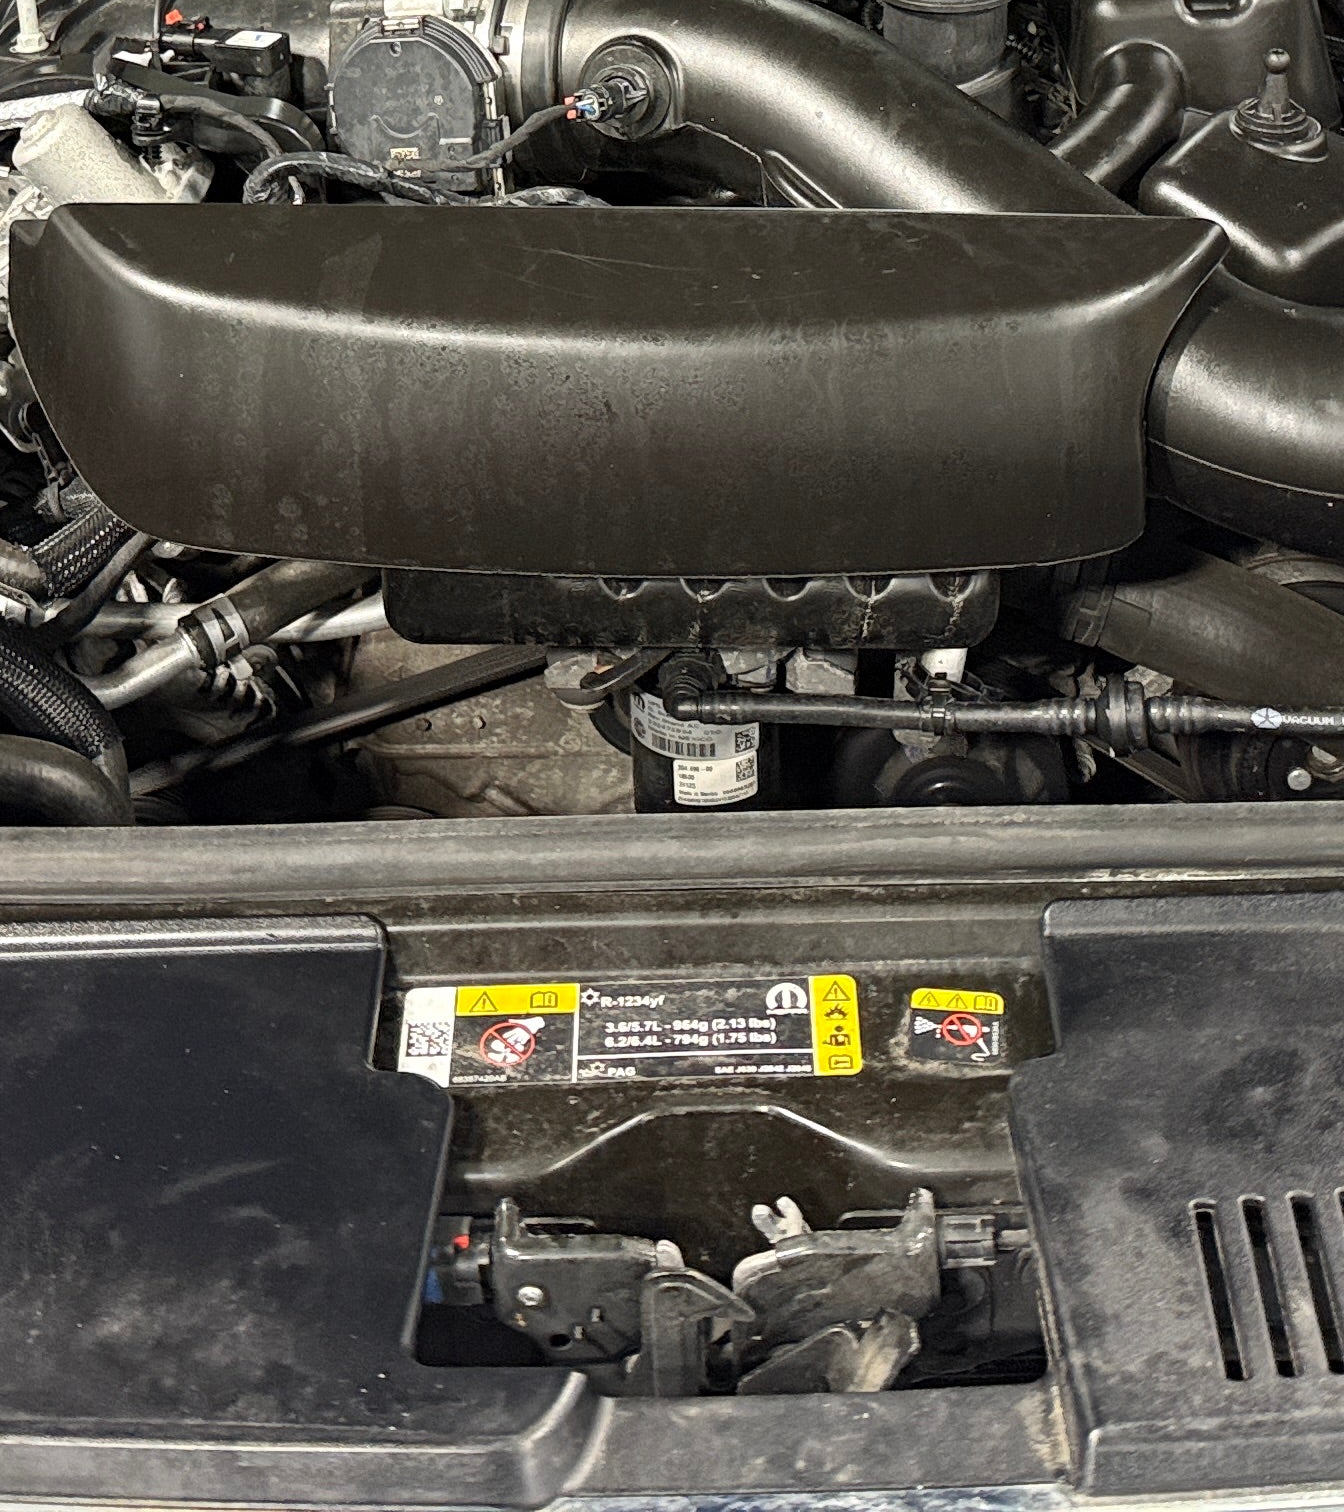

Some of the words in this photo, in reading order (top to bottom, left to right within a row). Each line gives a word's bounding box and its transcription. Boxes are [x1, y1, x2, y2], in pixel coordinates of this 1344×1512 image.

[1282, 715, 1334, 726] VACUUM
[600, 995, 665, 1008] R-1234yf
[605, 1020, 662, 1033] 3.6/5.7L
[712, 1018, 746, 1031] (2.13
[748, 1017, 776, 1030] lbs)
[712, 1032, 747, 1046] (1.75
[749, 1032, 777, 1045] lbs)
[608, 1067, 636, 1077] PAG
